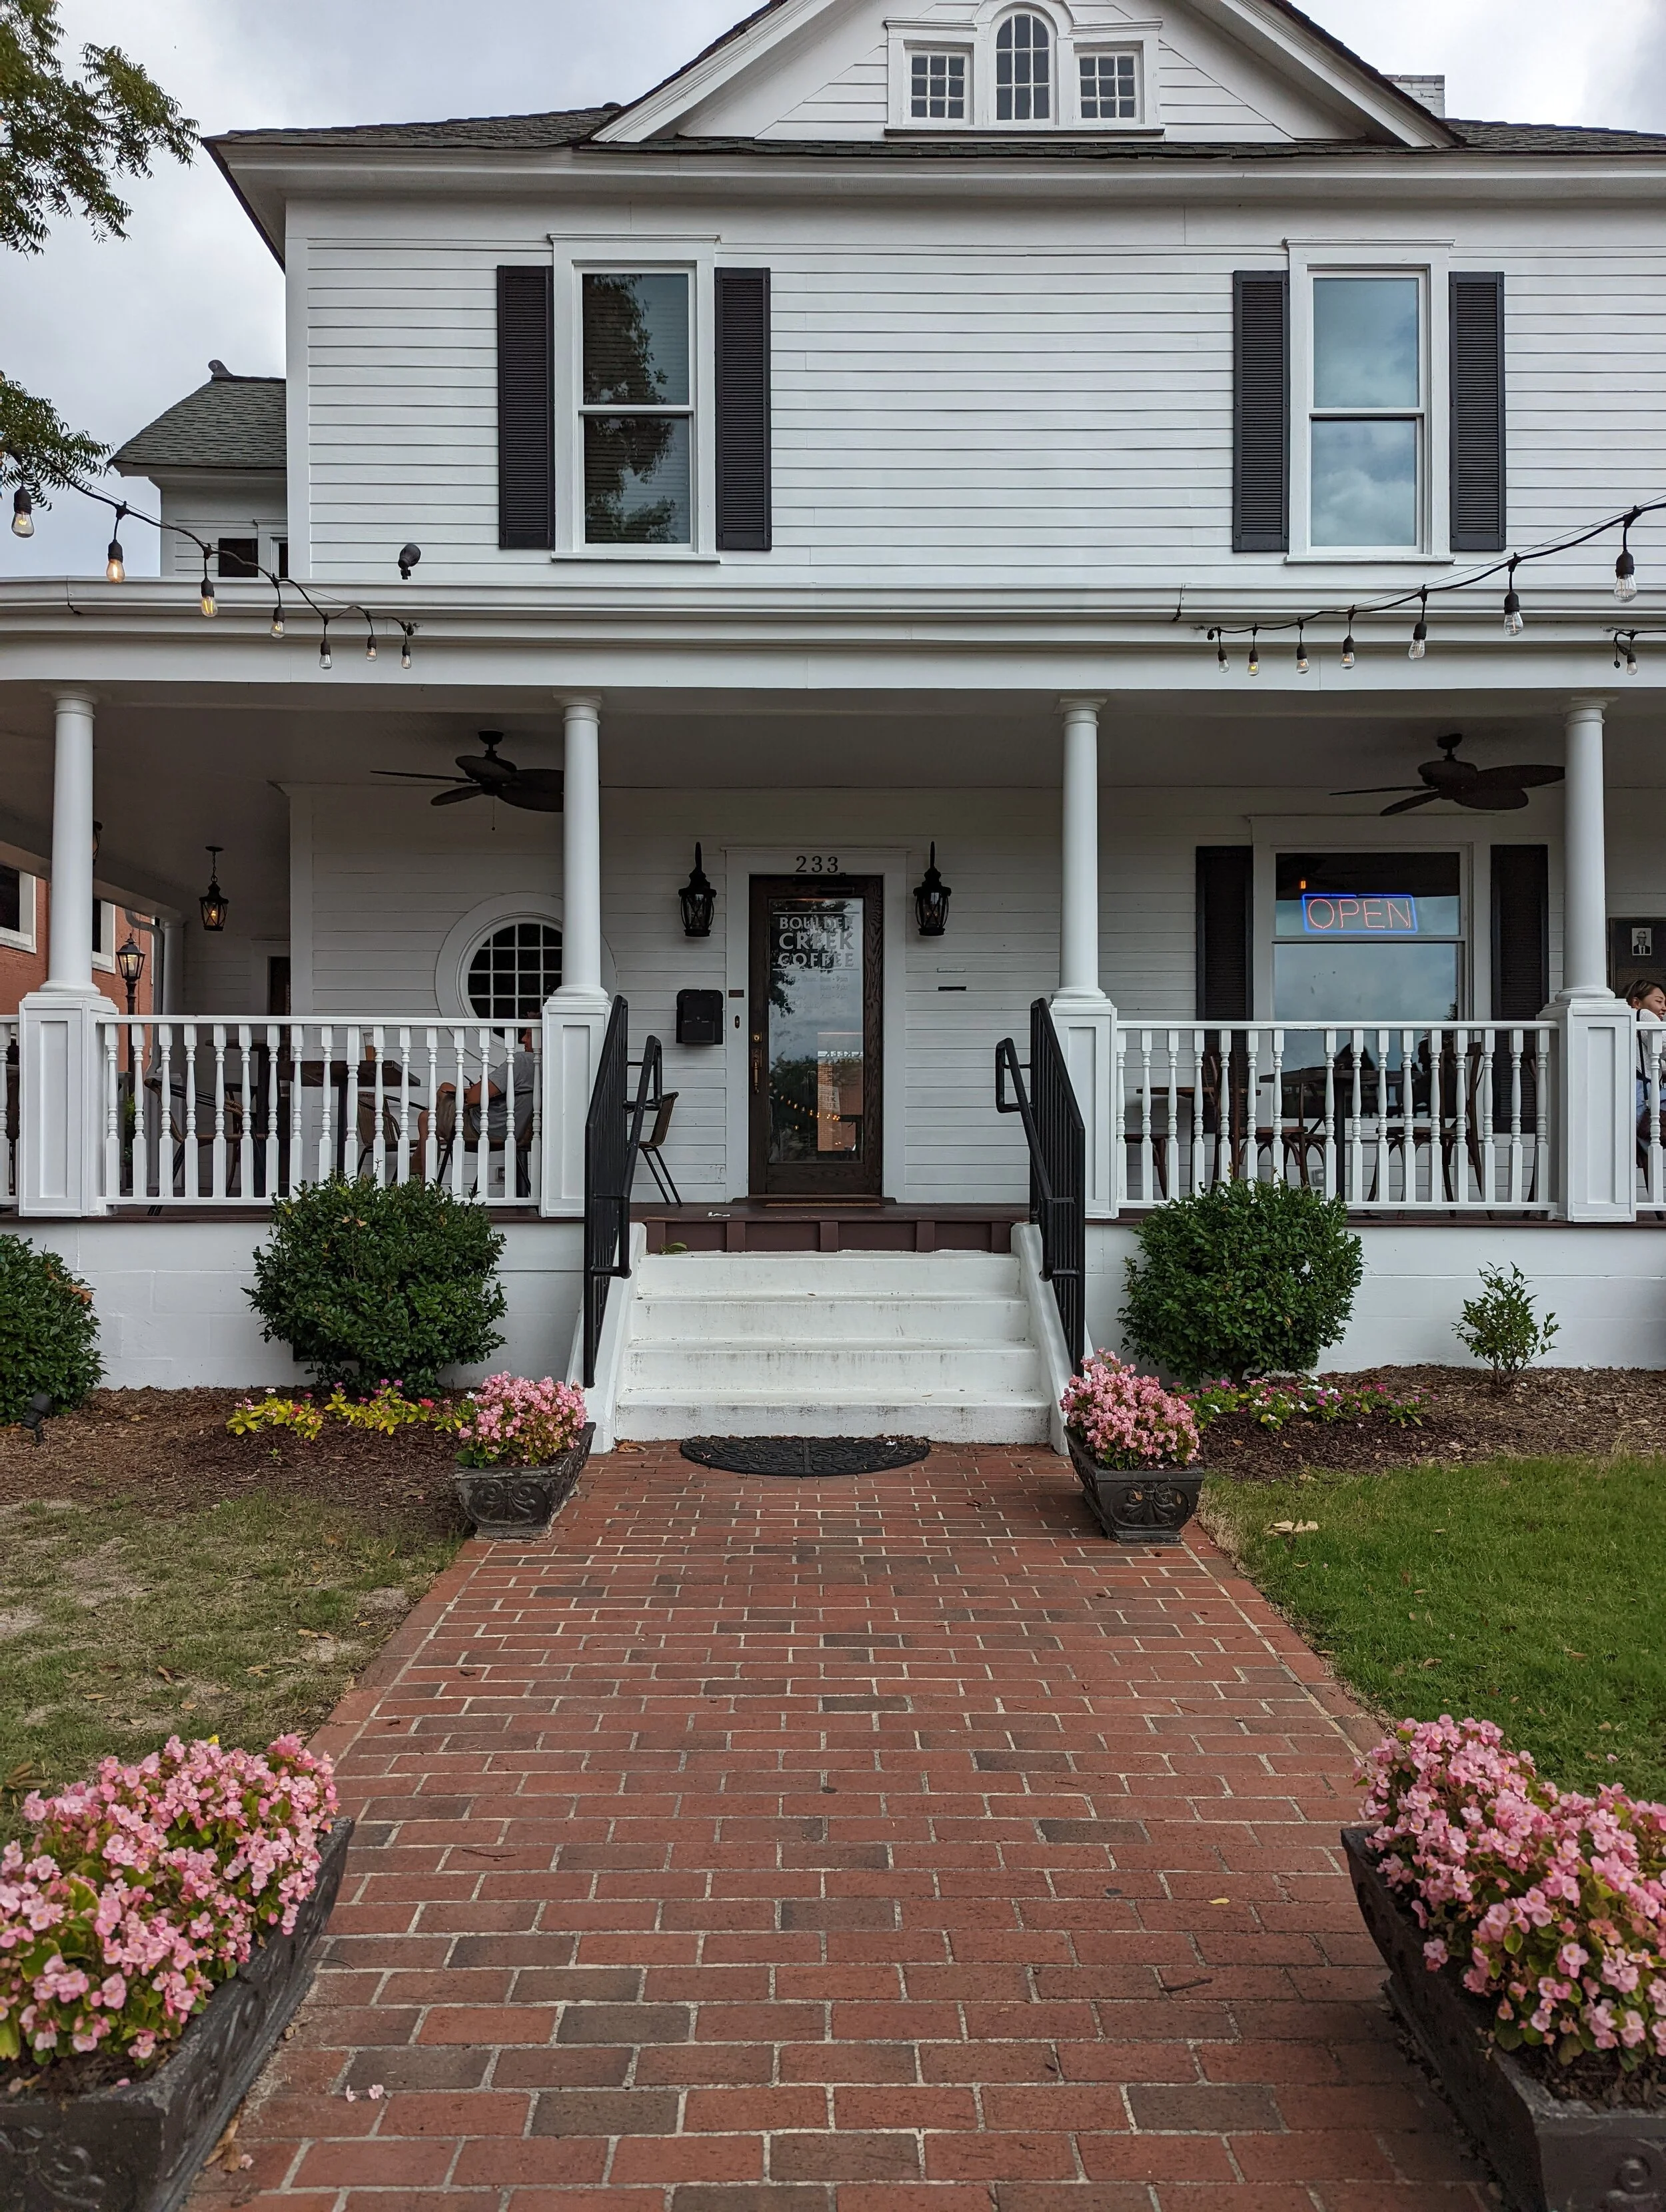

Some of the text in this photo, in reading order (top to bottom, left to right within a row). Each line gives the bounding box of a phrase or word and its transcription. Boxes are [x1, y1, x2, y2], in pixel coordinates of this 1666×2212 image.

[796, 855, 838, 873] 233
[1308, 899, 1411, 929] OPEN
[780, 917, 853, 929] BOULDER
[779, 932, 854, 949] CREEK
[778, 953, 854, 967] COFFEE
